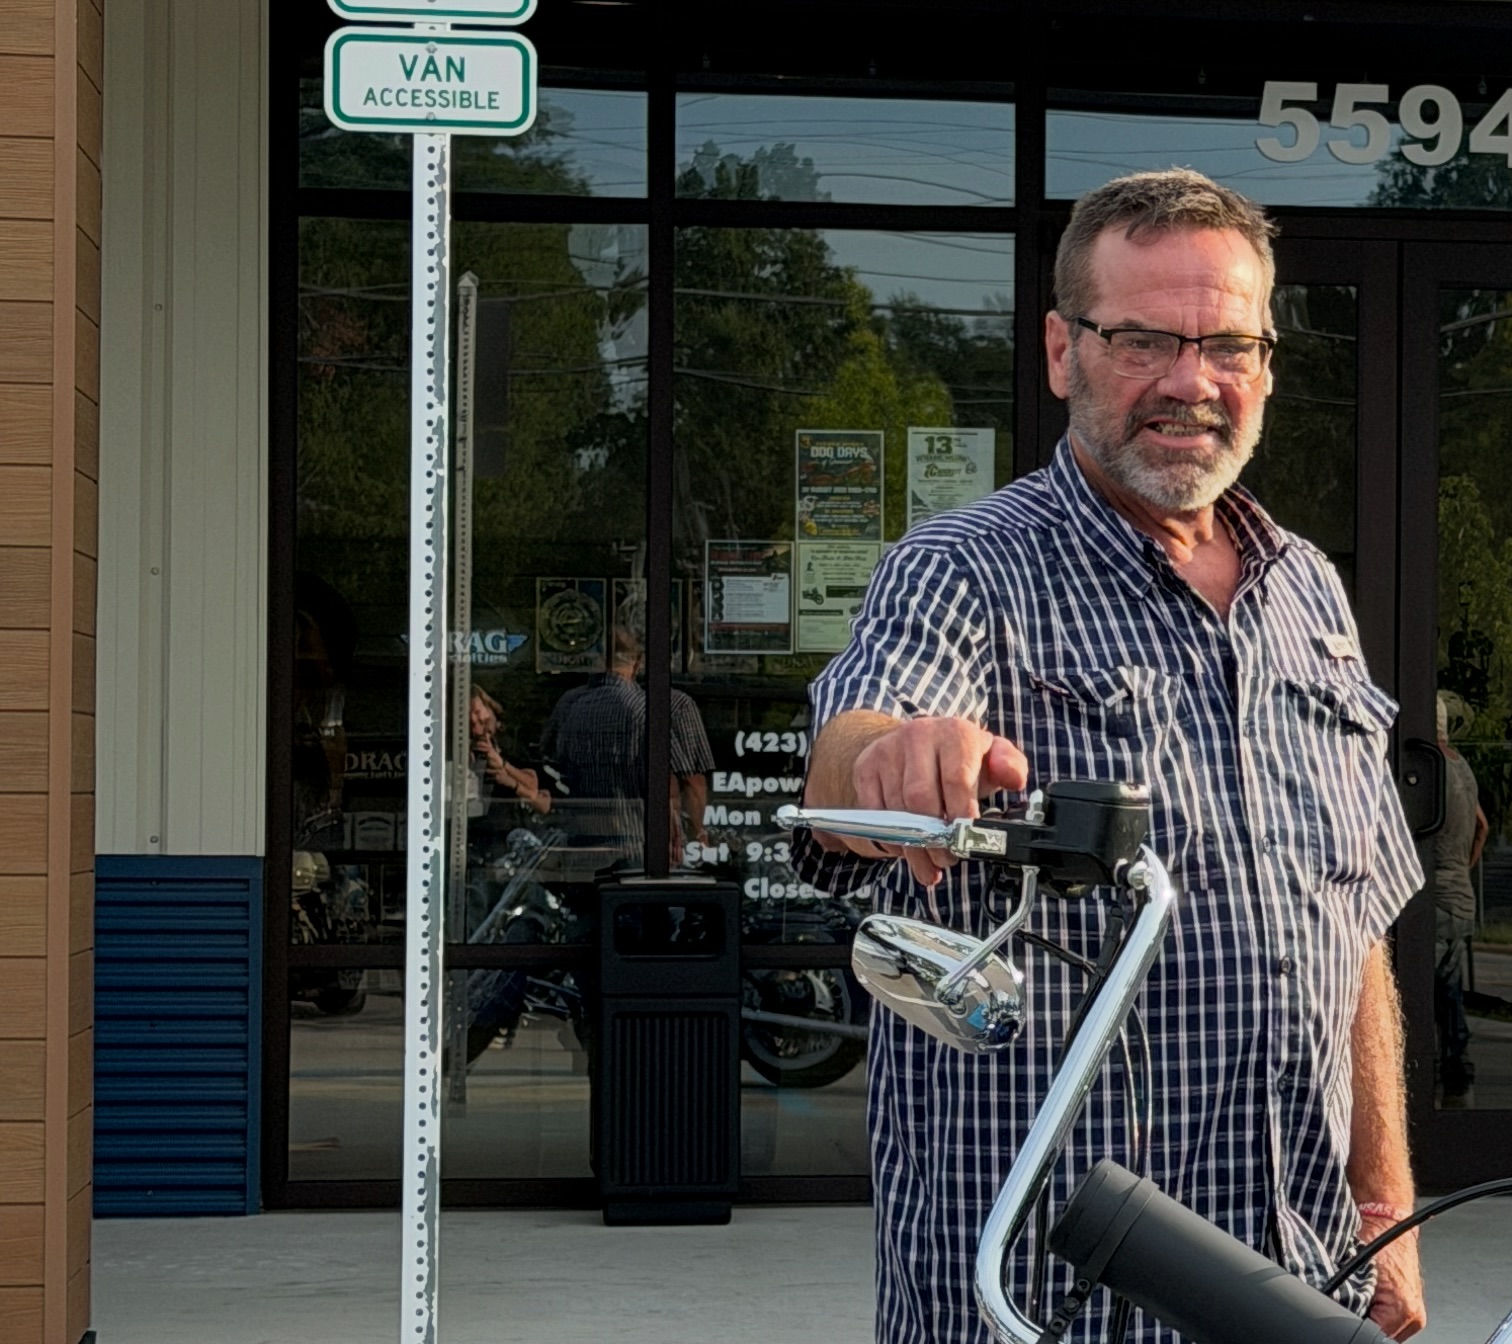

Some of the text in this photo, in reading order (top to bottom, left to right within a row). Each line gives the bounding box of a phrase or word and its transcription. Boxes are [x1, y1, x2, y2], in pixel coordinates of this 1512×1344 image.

[398, 53, 465, 83] VAN
[363, 87, 501, 110] ACCESSIBLE
[810, 445, 869, 459] DOG DAYS
[924, 436, 953, 454] 13
[448, 629, 508, 654] RAG
[734, 730, 808, 757] (423)
[712, 772, 804, 798] EApow
[702, 805, 761, 826] Mon
[746, 842, 791, 863] 9:3
